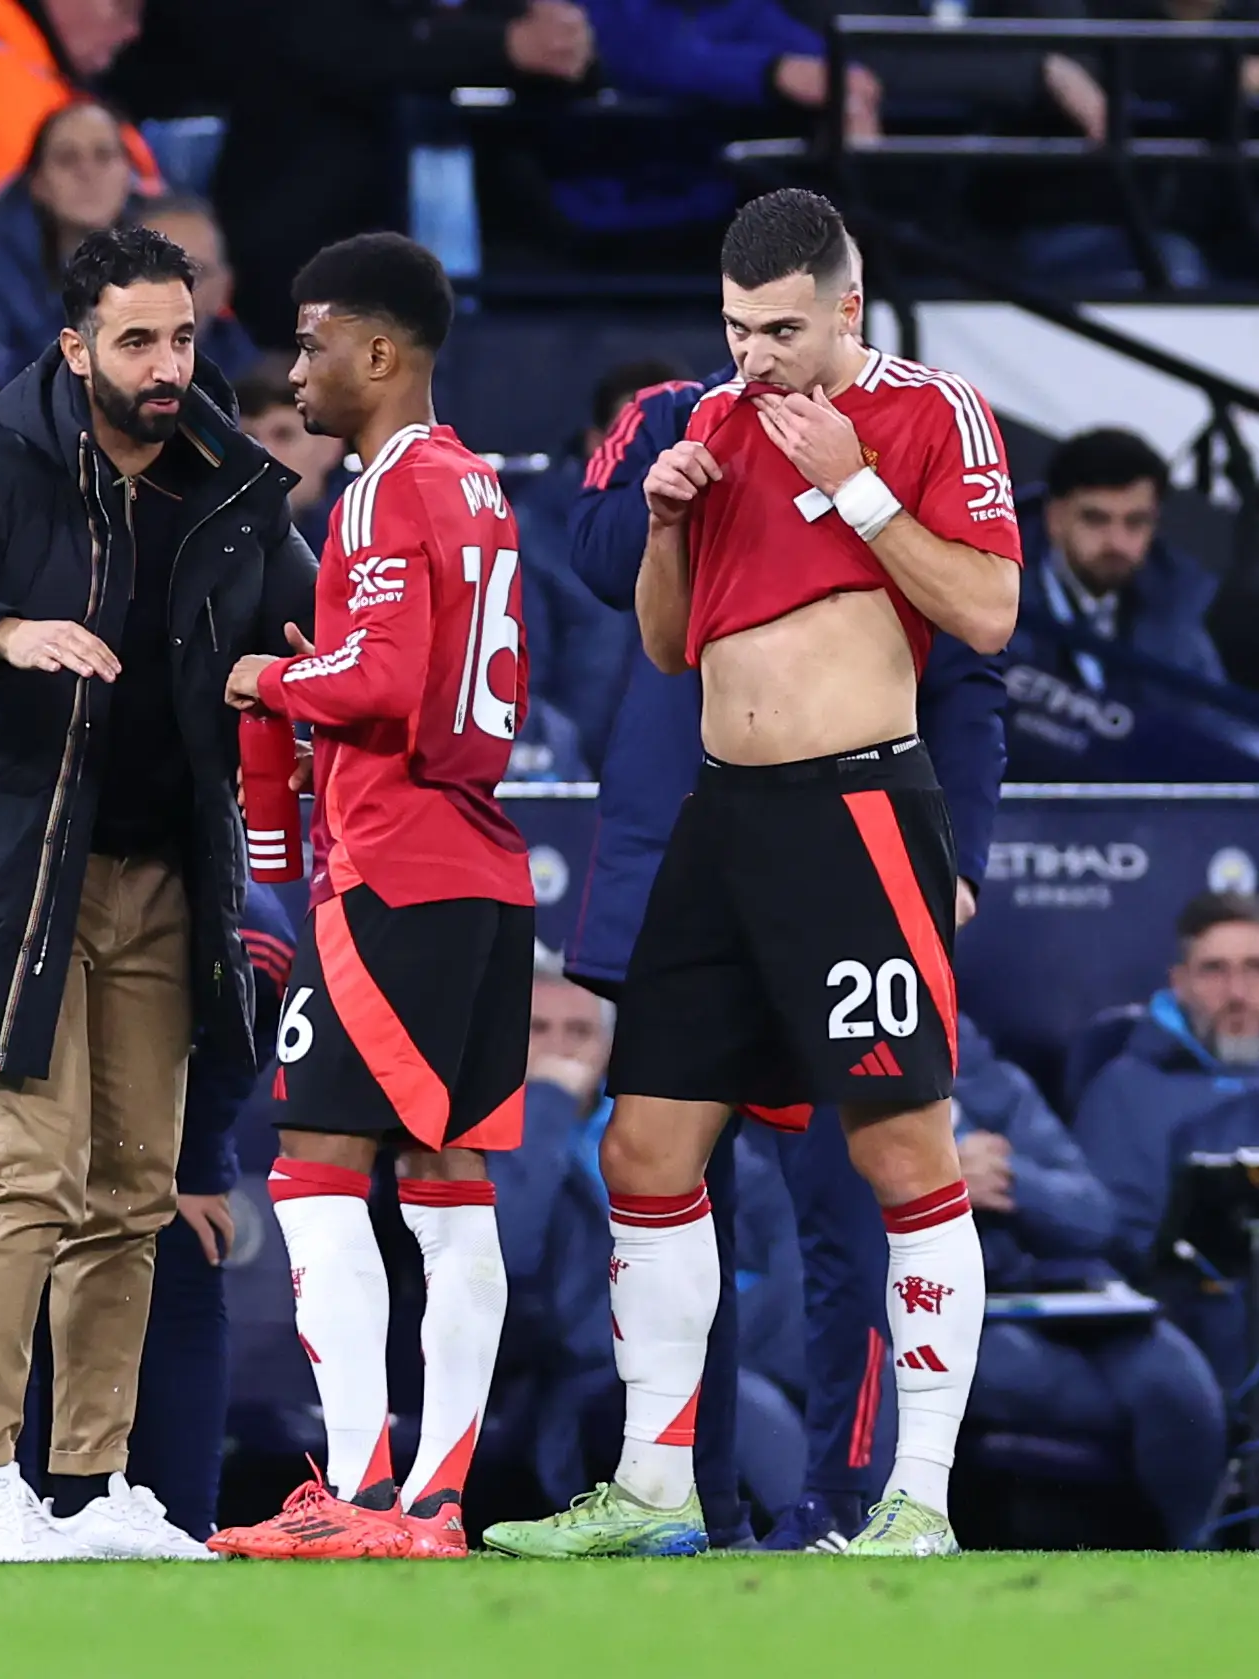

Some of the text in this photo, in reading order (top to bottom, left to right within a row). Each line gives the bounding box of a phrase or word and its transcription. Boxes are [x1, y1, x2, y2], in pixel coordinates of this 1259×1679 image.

[453, 545, 518, 741] 16
[276, 986, 315, 1064] 6
[826, 957, 919, 1040] 20
